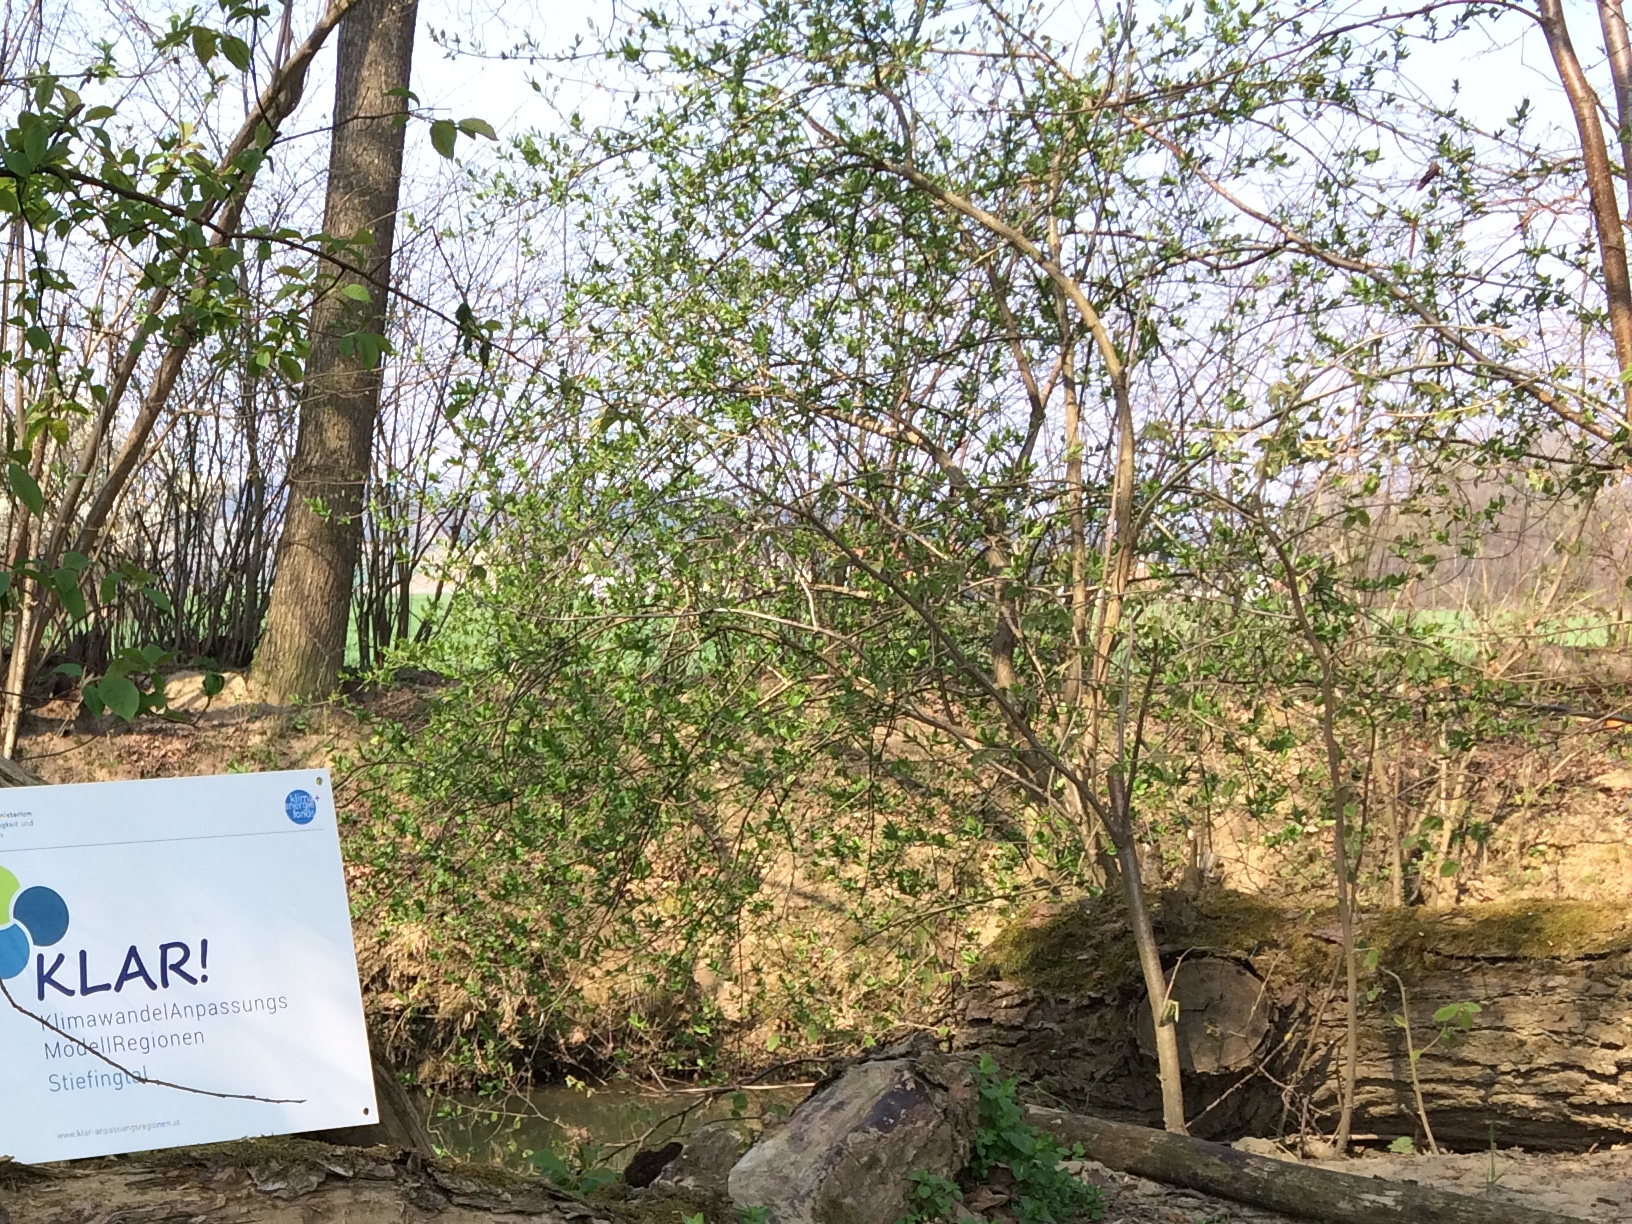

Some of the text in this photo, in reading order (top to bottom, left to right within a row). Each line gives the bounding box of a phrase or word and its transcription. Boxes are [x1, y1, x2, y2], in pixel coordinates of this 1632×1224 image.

[21, 820, 34, 828] und
[36, 938, 209, 1002] KLAR!
[40, 995, 288, 1032] KlimawandelAnpassungs
[44, 1029, 205, 1060] ModellRegionen
